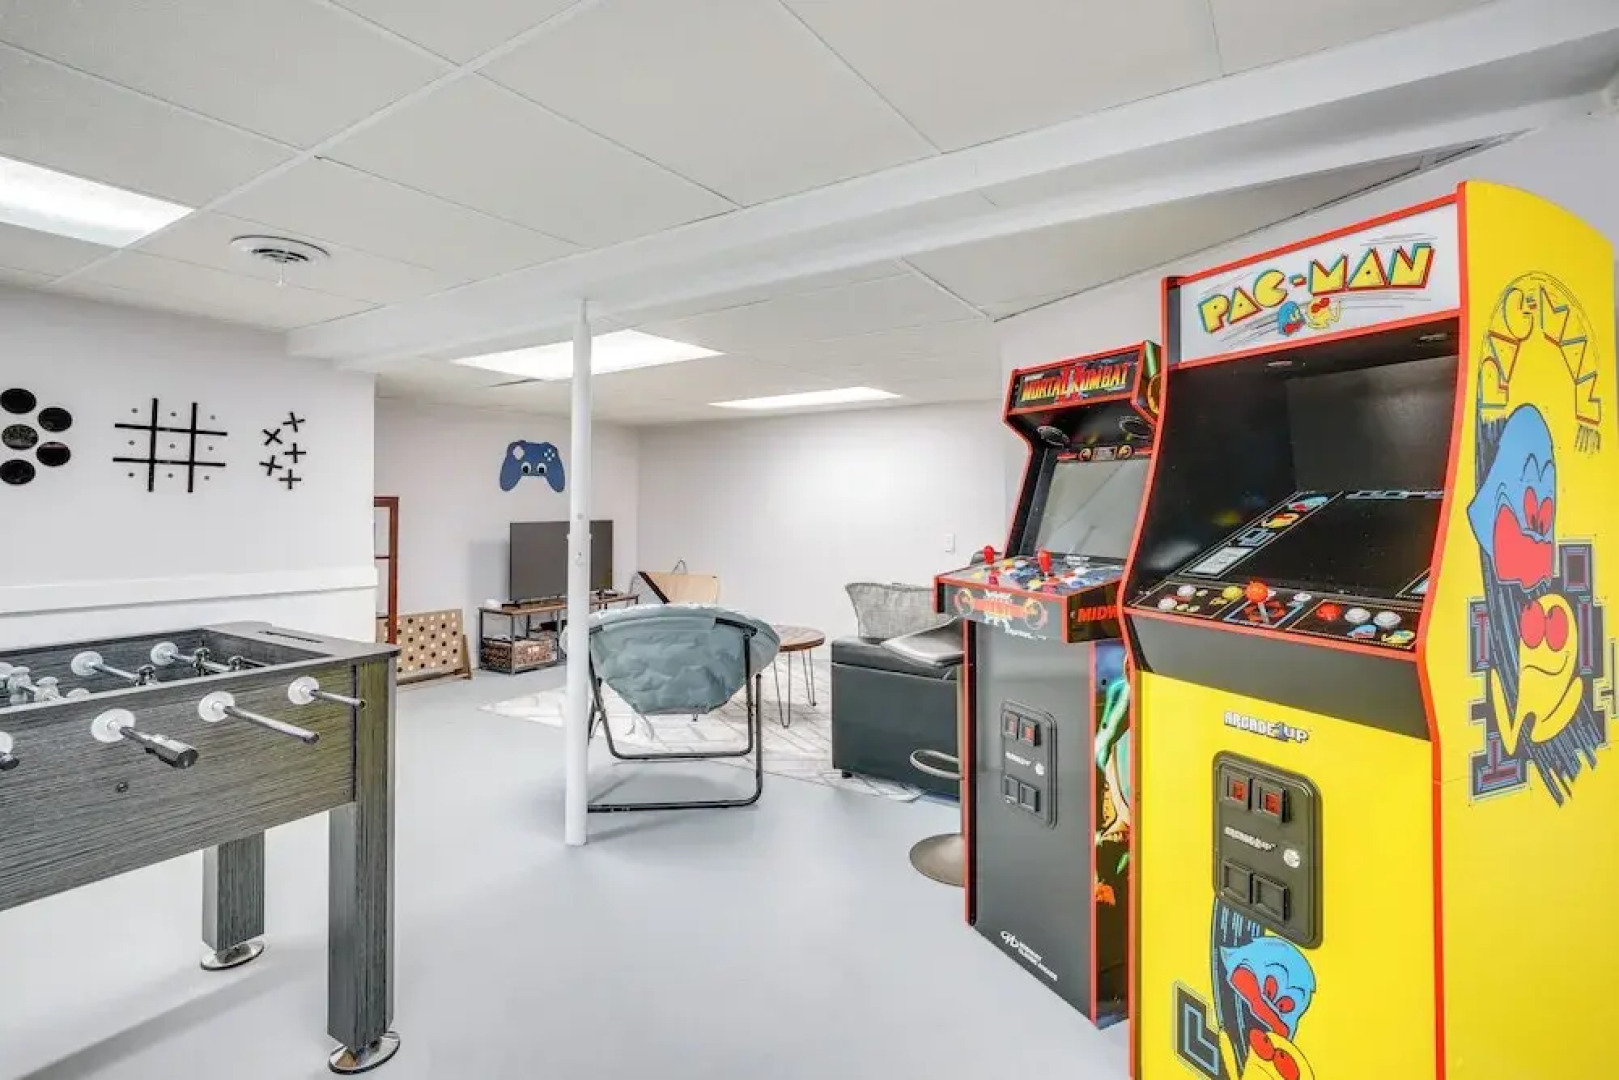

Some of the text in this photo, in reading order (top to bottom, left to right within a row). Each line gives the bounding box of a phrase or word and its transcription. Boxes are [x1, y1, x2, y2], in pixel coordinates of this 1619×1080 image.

[1198, 242, 1436, 334] PAC-MAN
[1021, 375, 1069, 402] MORTAL
[1068, 362, 1129, 396] KOMBAT
